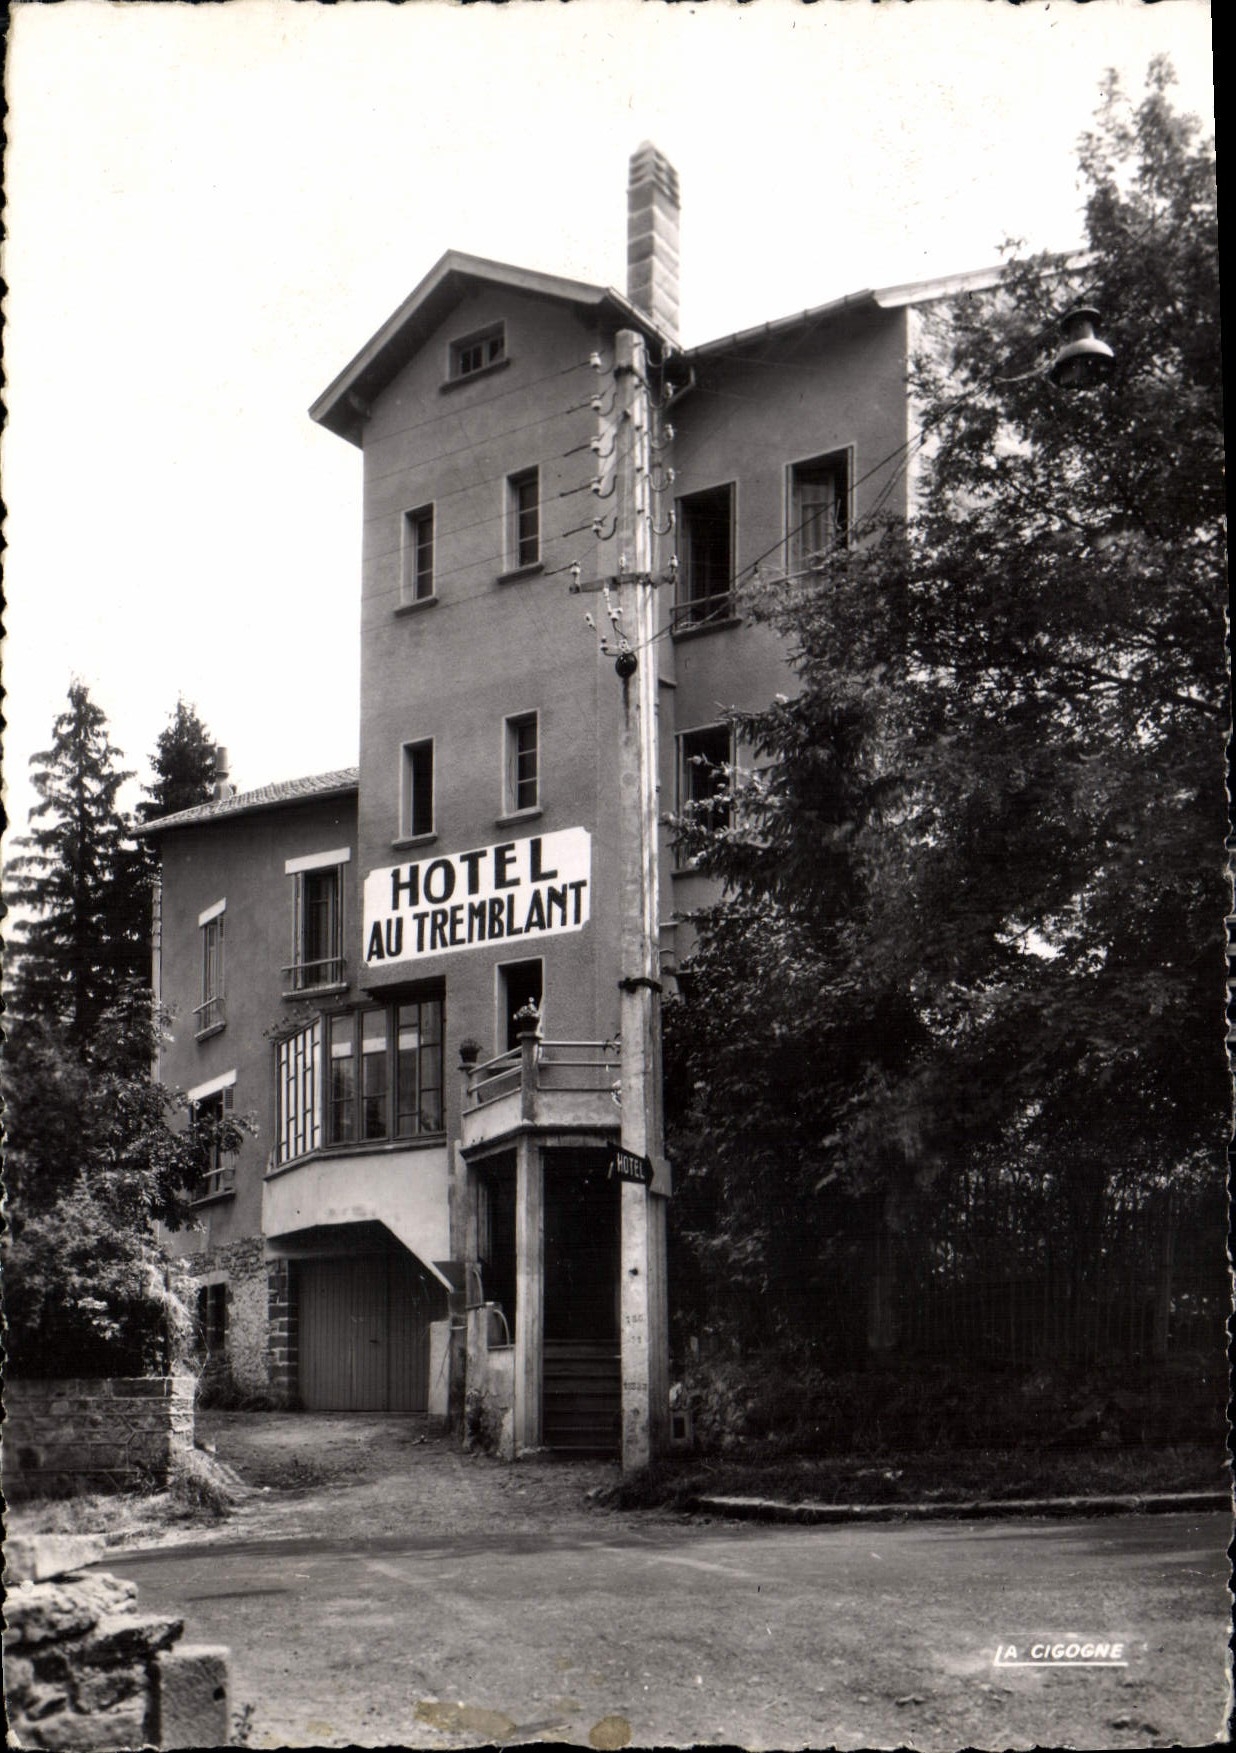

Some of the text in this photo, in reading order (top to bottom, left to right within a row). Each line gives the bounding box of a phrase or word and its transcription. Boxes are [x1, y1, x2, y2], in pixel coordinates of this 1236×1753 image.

[391, 838, 558, 911] HOTEL
[366, 880, 588, 962] AU TREMBLANT
[617, 1152, 646, 1180] HOTEL
